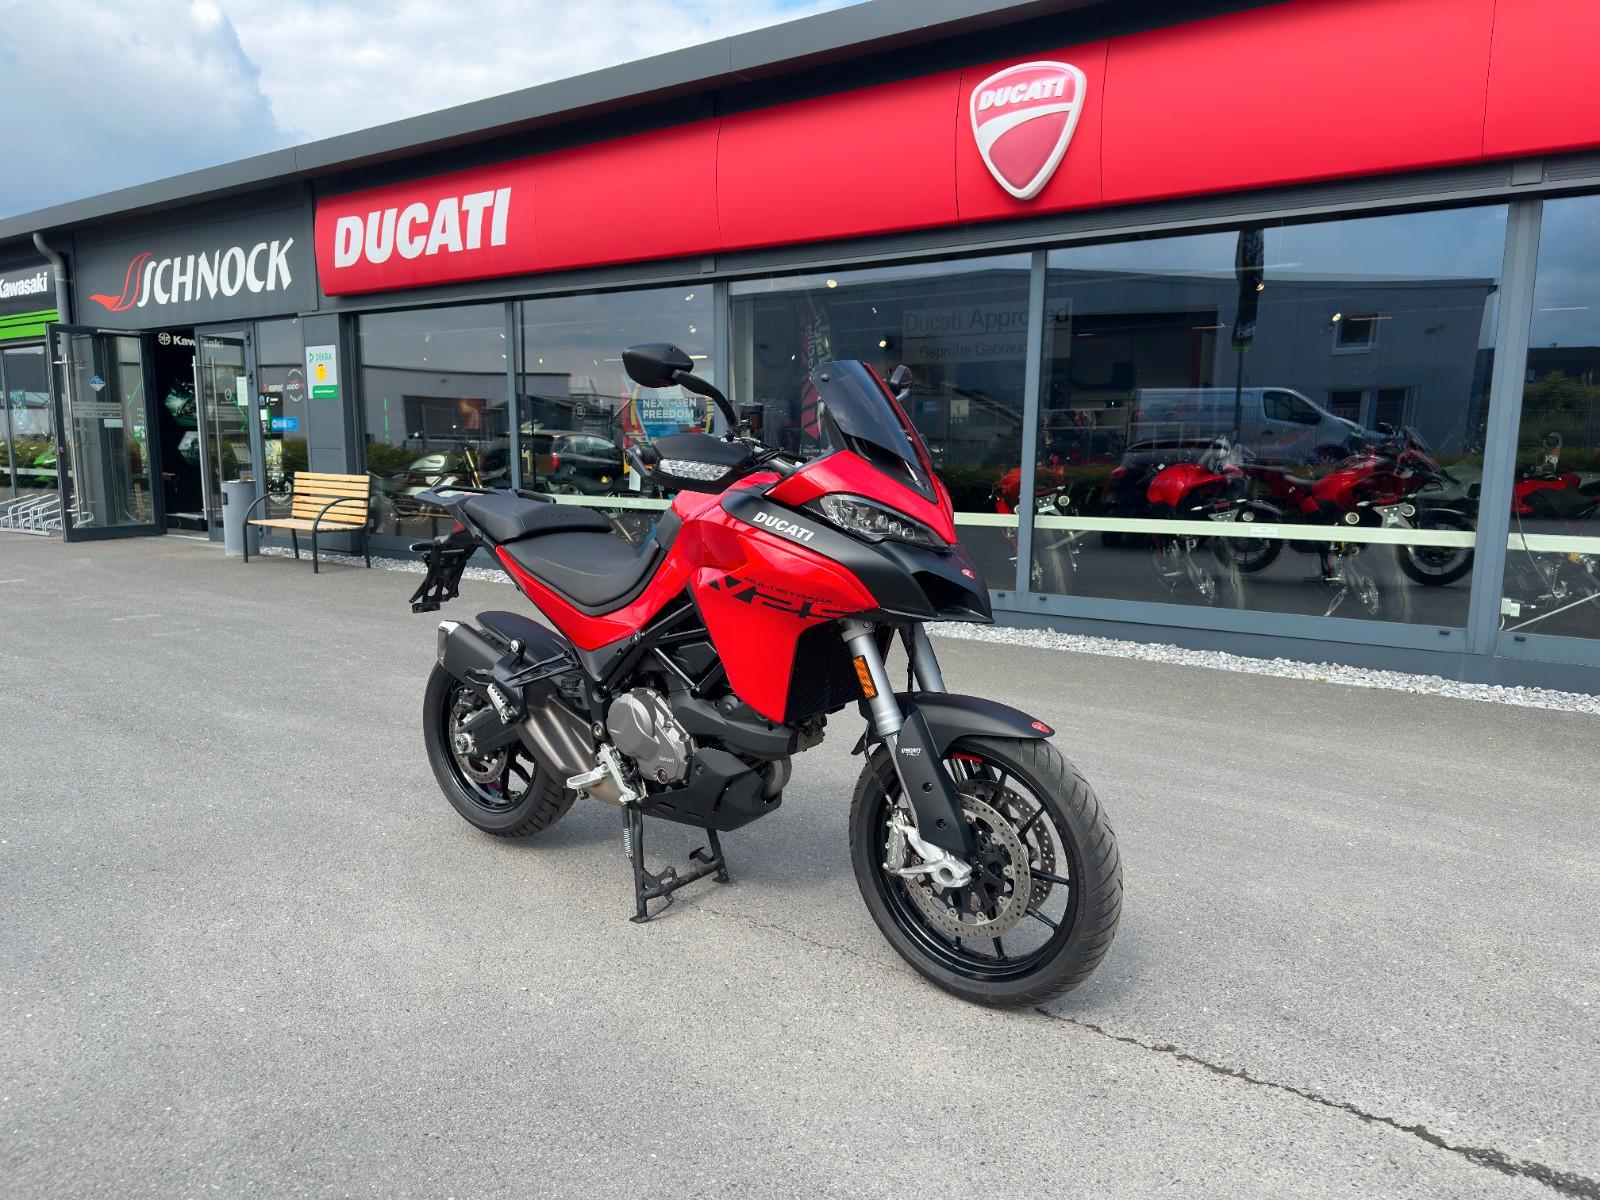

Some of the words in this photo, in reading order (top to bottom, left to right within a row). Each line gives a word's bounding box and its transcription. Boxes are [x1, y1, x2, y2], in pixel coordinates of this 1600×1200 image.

[979, 76, 1067, 111] DUCATI
[334, 186, 512, 269] DUCATI
[137, 237, 294, 308] SCHNOCK
[905, 310, 962, 333] Ducati
[969, 301, 1070, 332] Approed
[173, 335, 224, 348] Kawsaki
[975, 340, 1049, 356] Gebrauce
[643, 398, 697, 408] NEXT-GEN
[643, 409, 694, 419] FREEDOM
[752, 511, 815, 541] DUCATI
